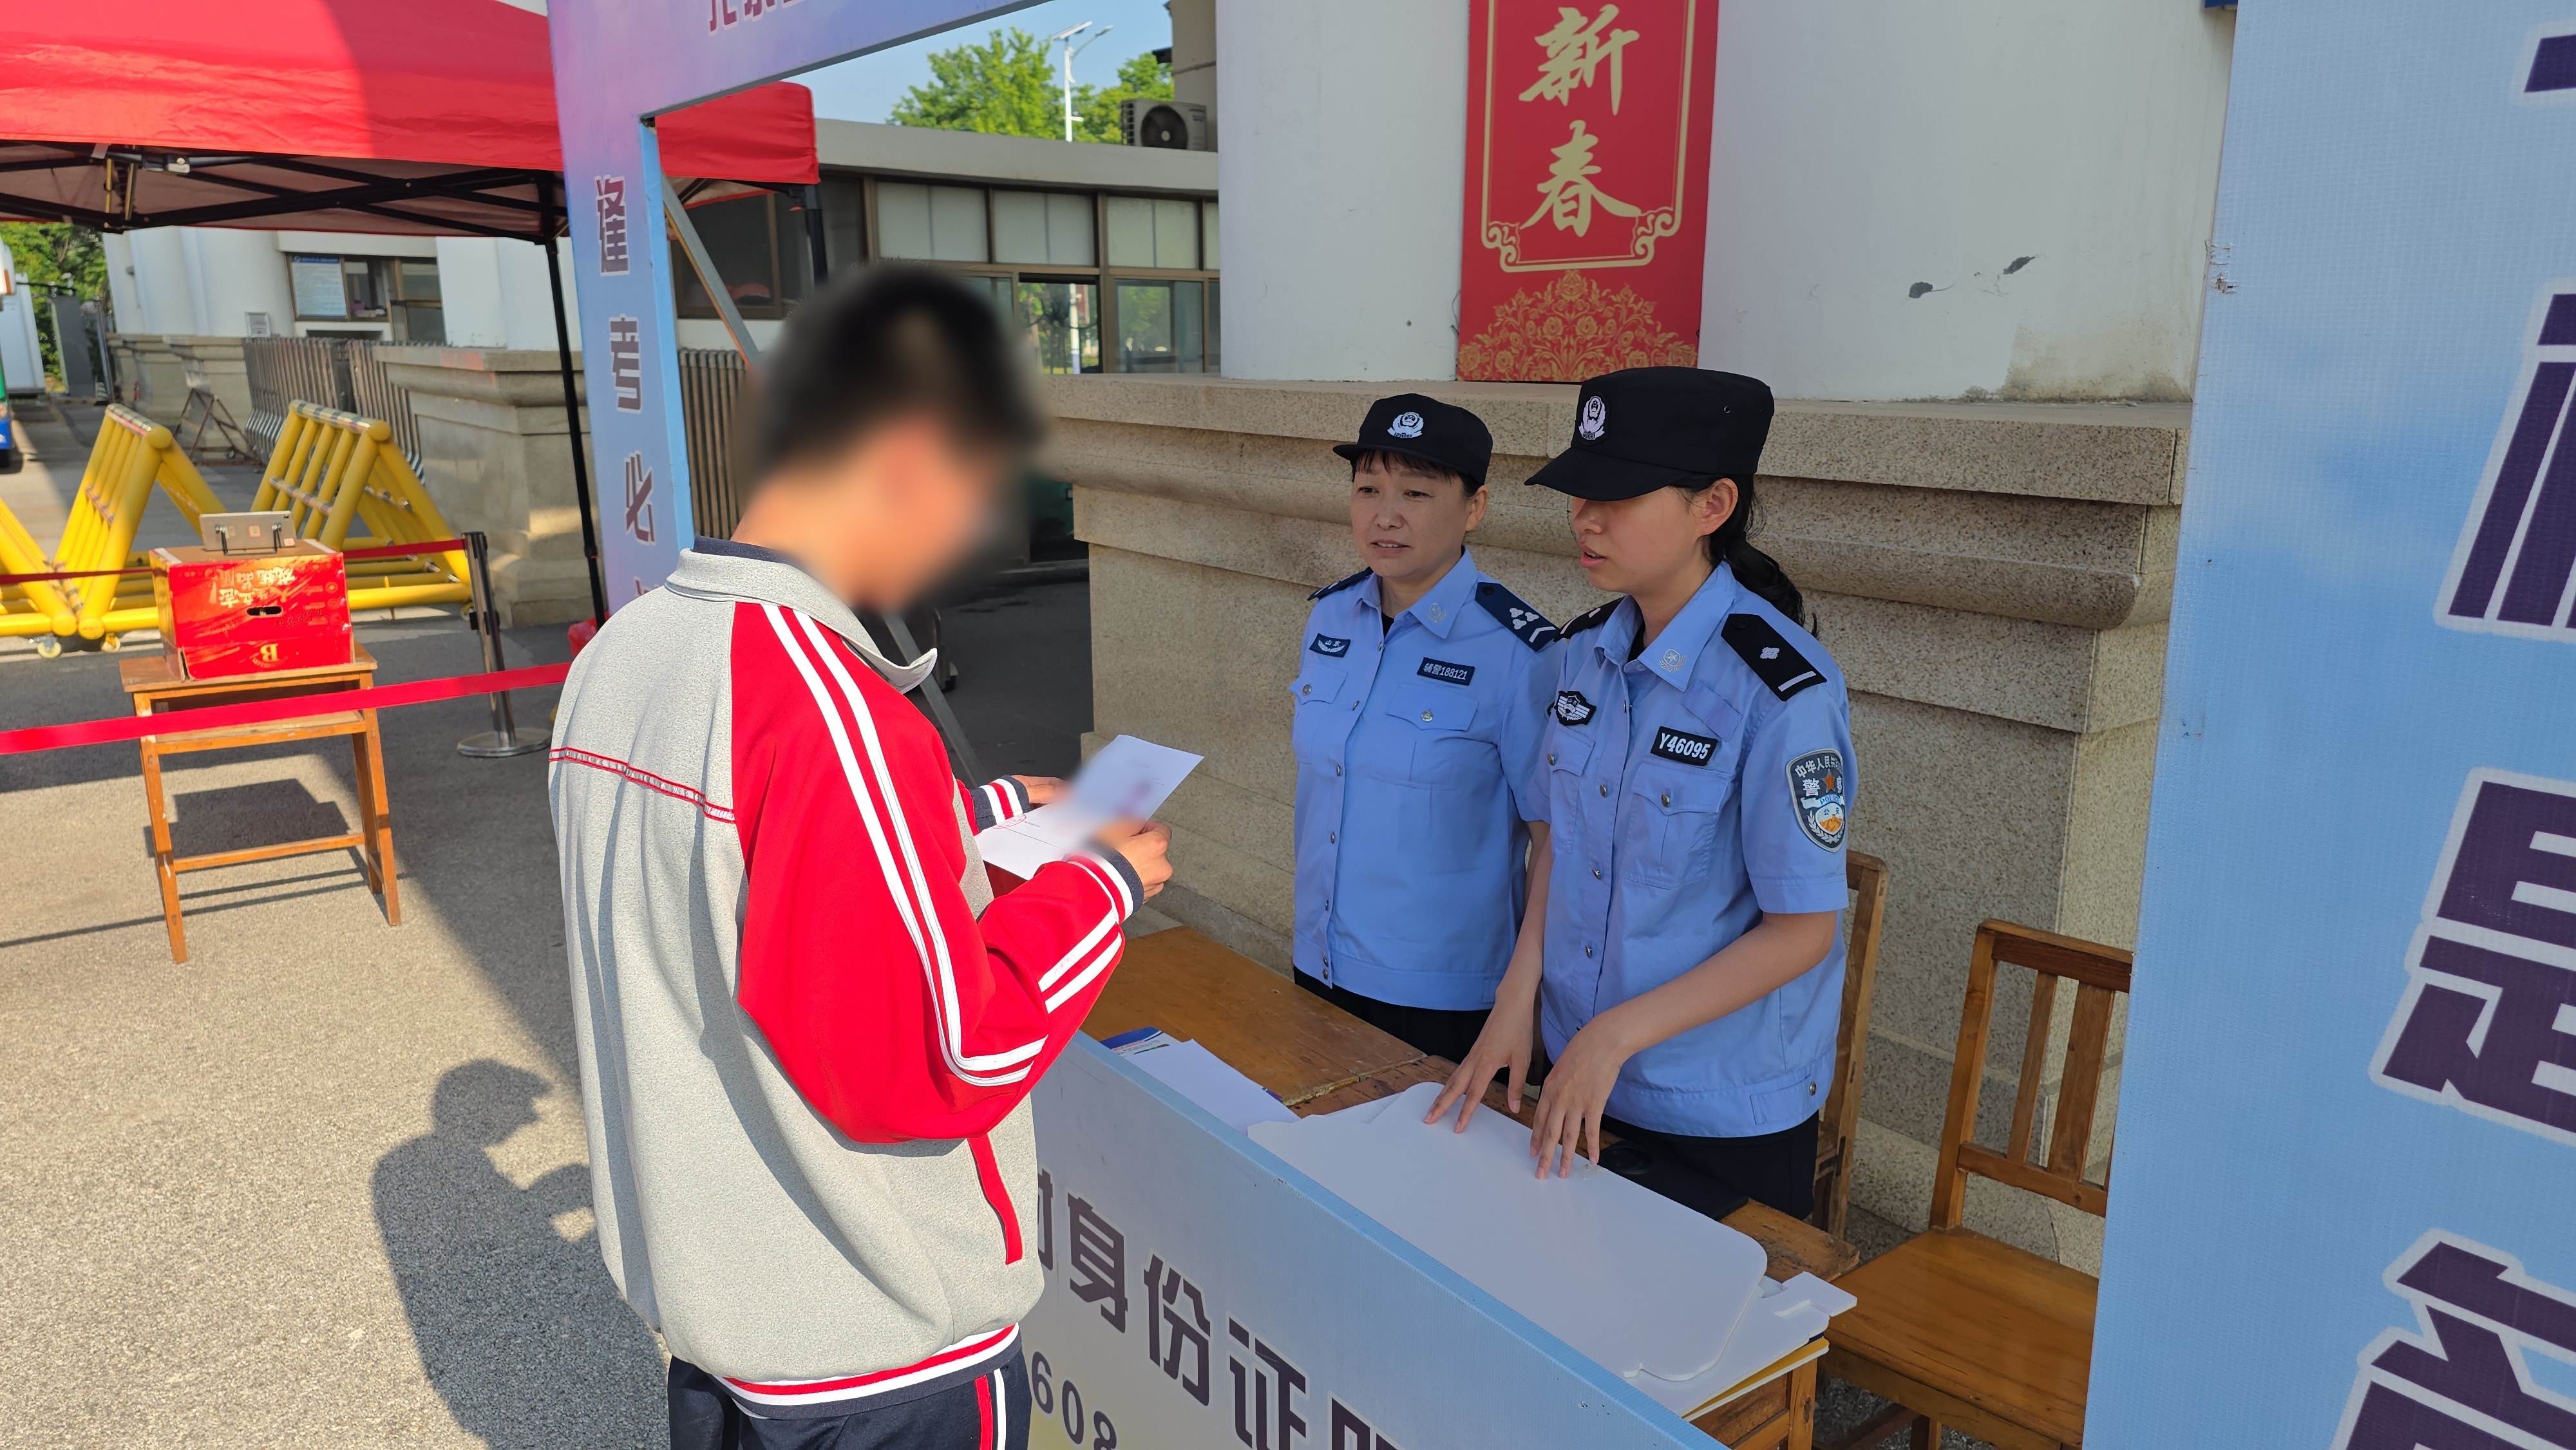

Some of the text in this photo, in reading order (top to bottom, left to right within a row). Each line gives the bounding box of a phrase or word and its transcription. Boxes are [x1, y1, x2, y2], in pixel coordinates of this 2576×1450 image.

[1519, 4, 1642, 237] 新春
[596, 175, 660, 596] 逢考必
[1325, 639, 1341, 648] 山东
[1423, 662, 1468, 680] 辅警188121
[1659, 733, 1710, 760] Y46095
[1037, 1168, 1399, 1450] 身份证
